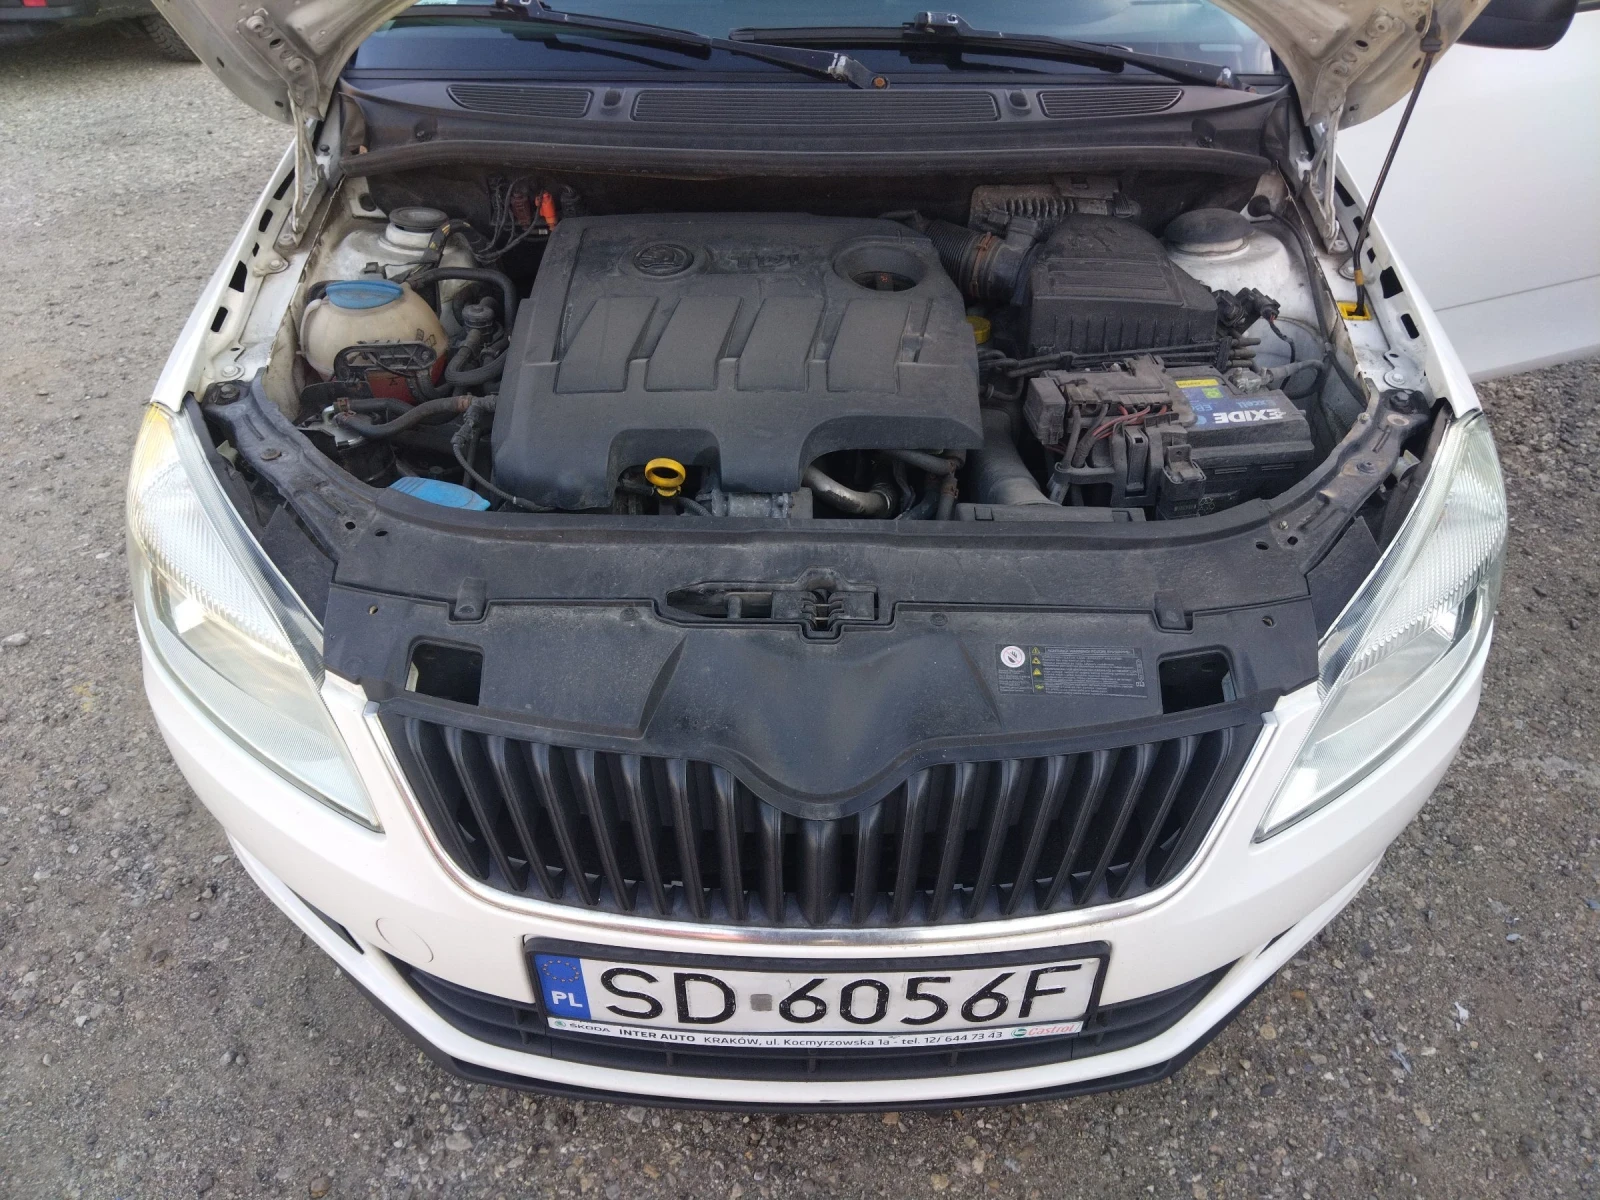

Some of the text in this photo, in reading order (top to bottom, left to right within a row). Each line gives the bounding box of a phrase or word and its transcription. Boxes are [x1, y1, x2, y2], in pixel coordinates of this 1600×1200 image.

[1212, 407, 1287, 424] EXIDE
[551, 990, 583, 1008] PL
[600, 963, 1083, 1026] SD 6056F
[619, 1028, 657, 1039] INTER
[660, 1033, 696, 1042] AUTO
[704, 1035, 762, 1047] KRAKÓW,
[766, 1038, 780, 1046] ul.
[783, 1038, 874, 1048] Kocmyrzowska
[902, 1037, 921, 1046] tel.
[944, 1034, 968, 1042] 644
[1028, 1023, 1076, 1037] Castrol
